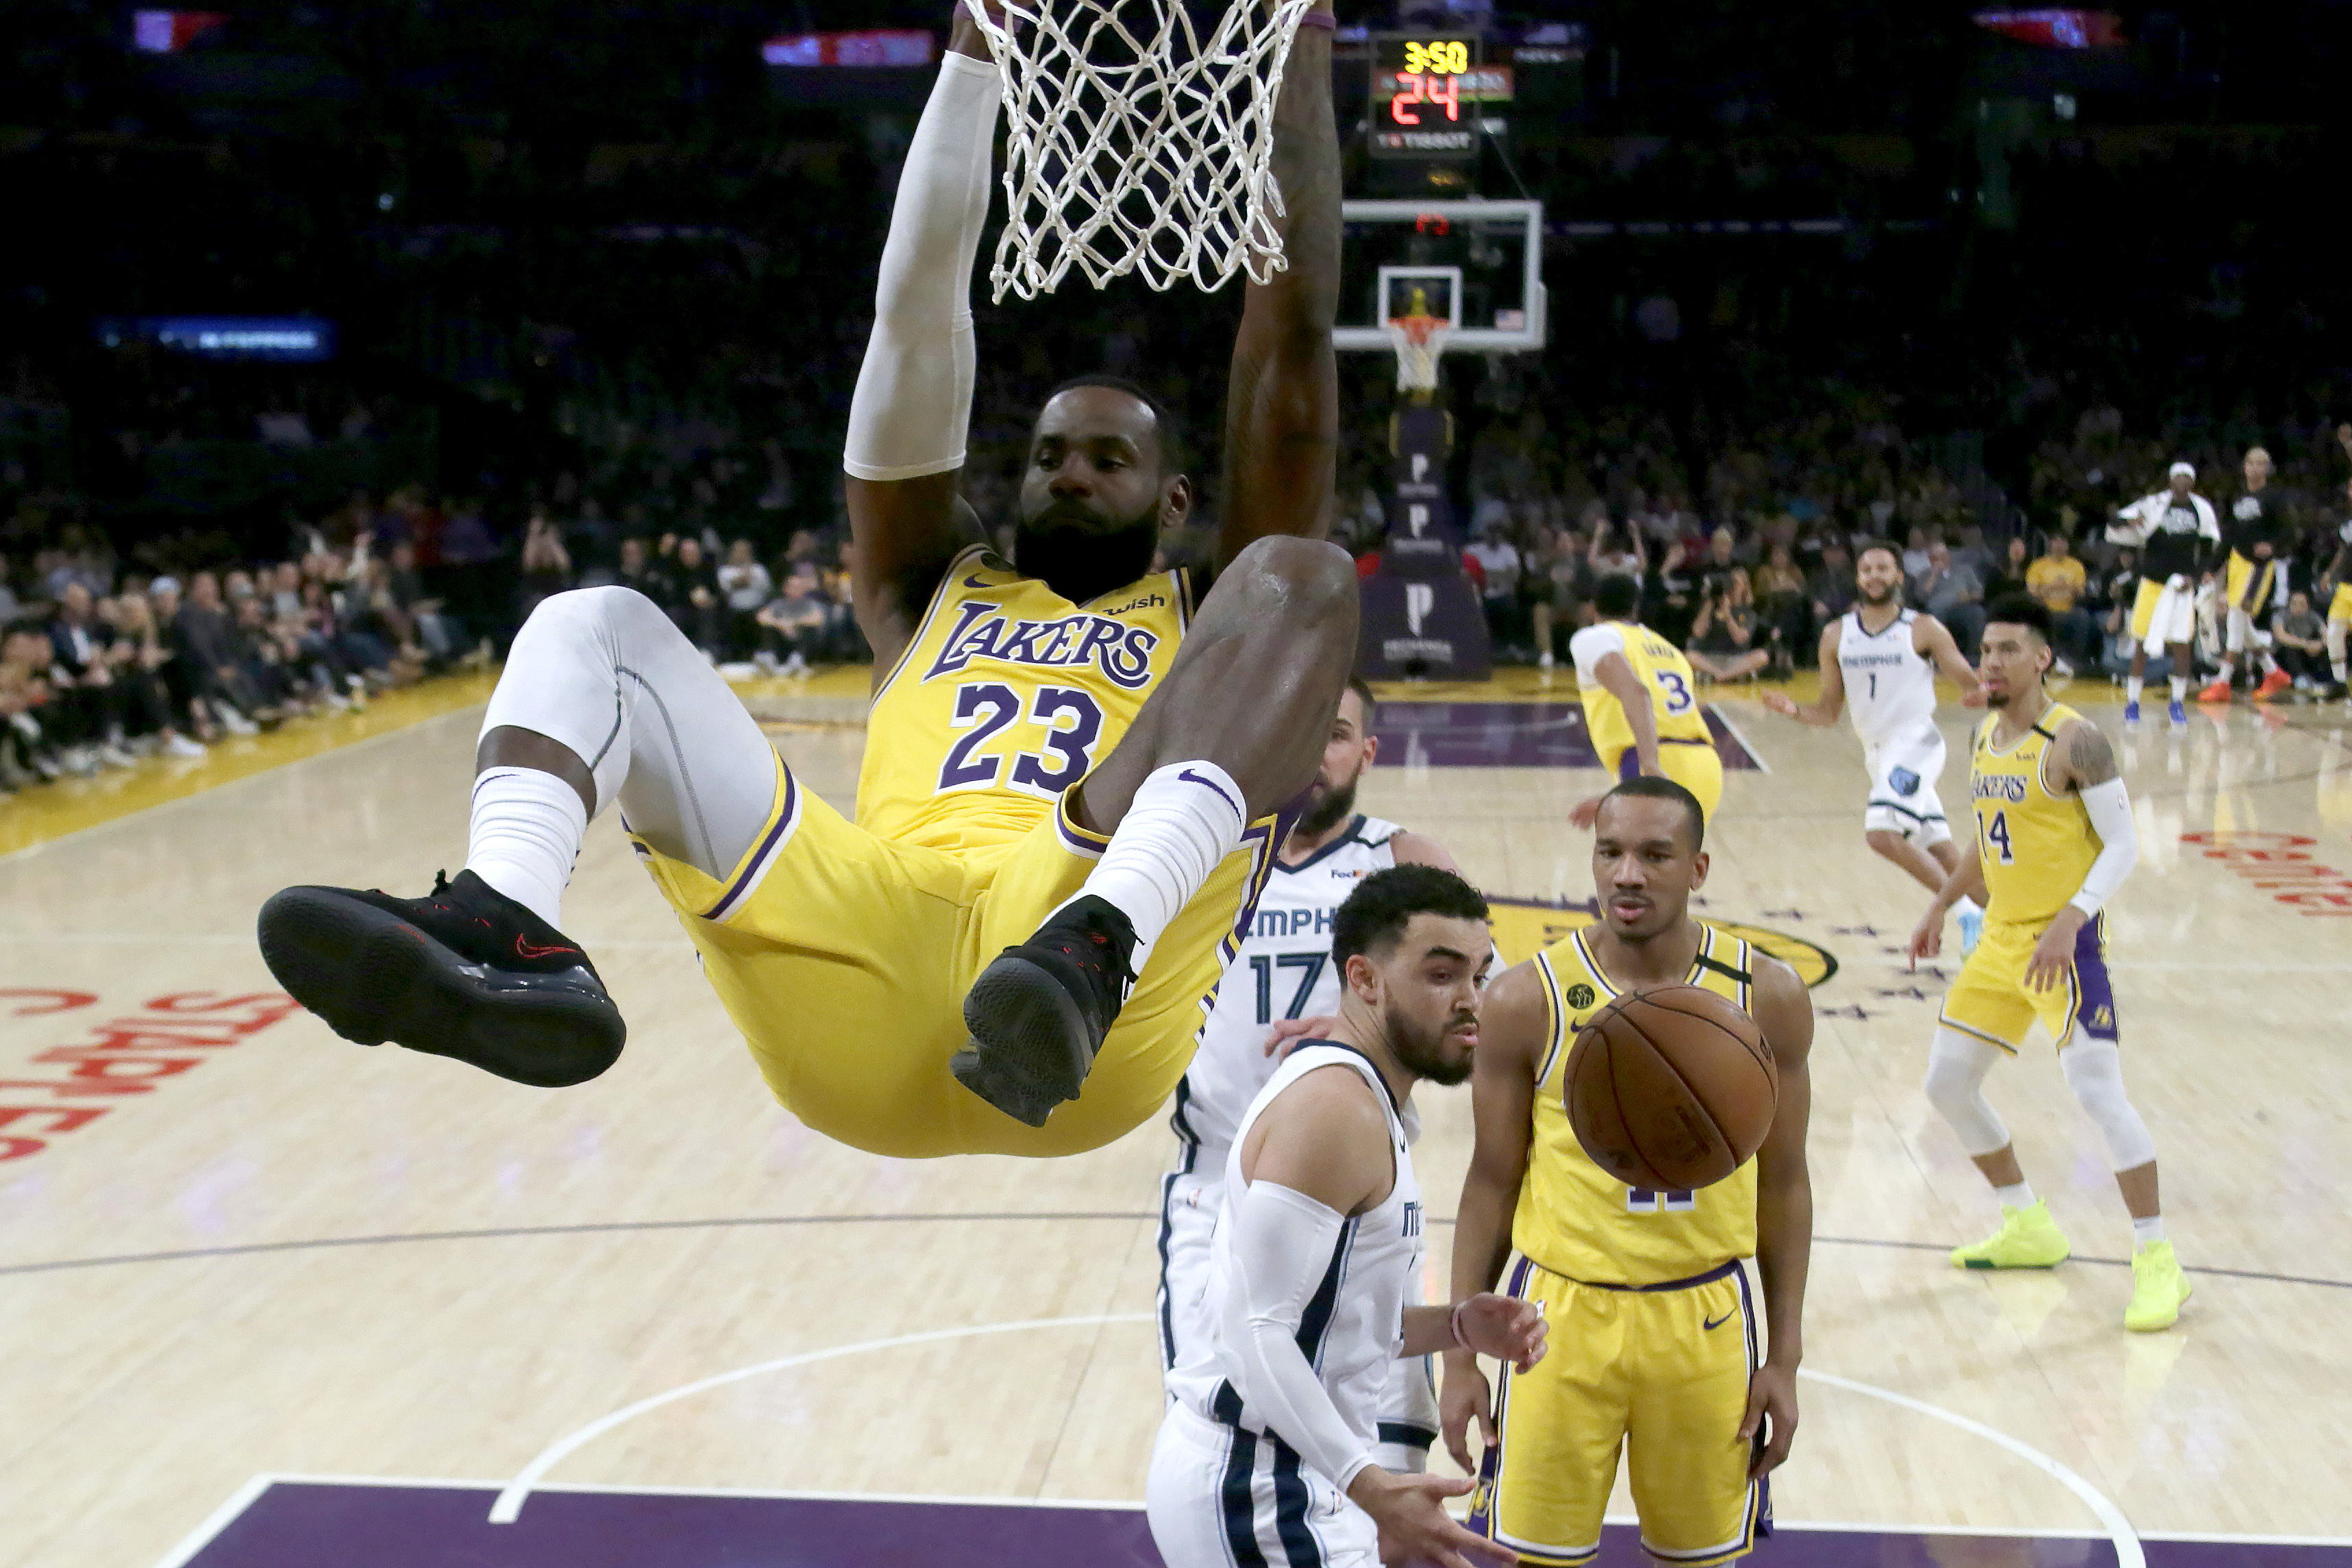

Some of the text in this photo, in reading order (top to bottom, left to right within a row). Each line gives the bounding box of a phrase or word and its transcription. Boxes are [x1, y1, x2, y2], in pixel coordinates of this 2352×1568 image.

[1404, 41, 1468, 74] 3:50
[1391, 72, 1459, 125] 24
[1103, 593, 1165, 616] wish
[920, 599, 1161, 691] LAKERS
[1655, 669, 1694, 717] 3
[1868, 672, 1876, 701] 1
[933, 682, 1106, 802] 23
[1976, 808, 2014, 865] 14
[1250, 951, 1329, 1024] 17
